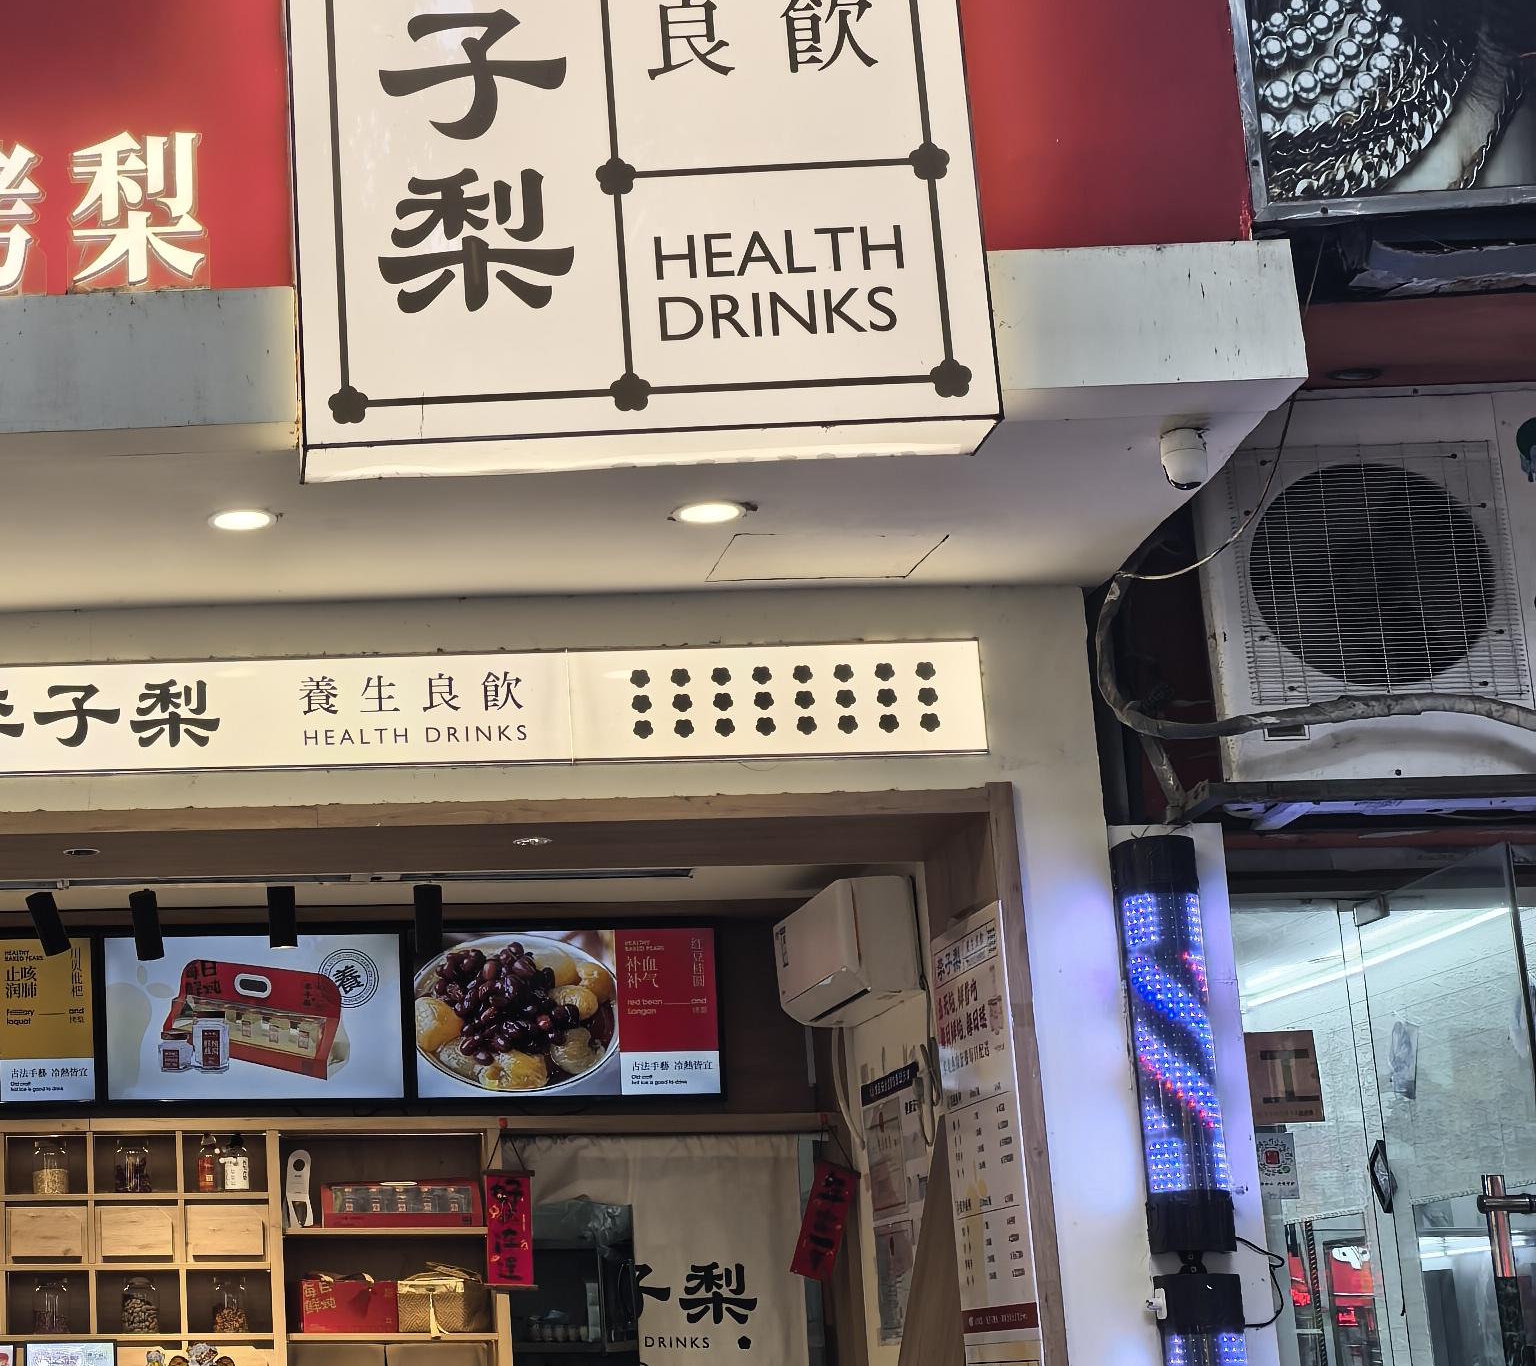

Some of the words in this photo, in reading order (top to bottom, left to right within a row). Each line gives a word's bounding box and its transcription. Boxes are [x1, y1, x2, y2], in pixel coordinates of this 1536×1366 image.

[654, 225, 905, 280] HEALTH
[660, 286, 898, 342] DRINKS
[298, 671, 525, 715] 養生良飲
[303, 726, 410, 747] HEALTH
[425, 724, 529, 745] DRINKS
[5, 966, 37, 982] 止咳
[5, 983, 37, 999] 润肺
[644, 1336, 711, 1349] DRINKS
